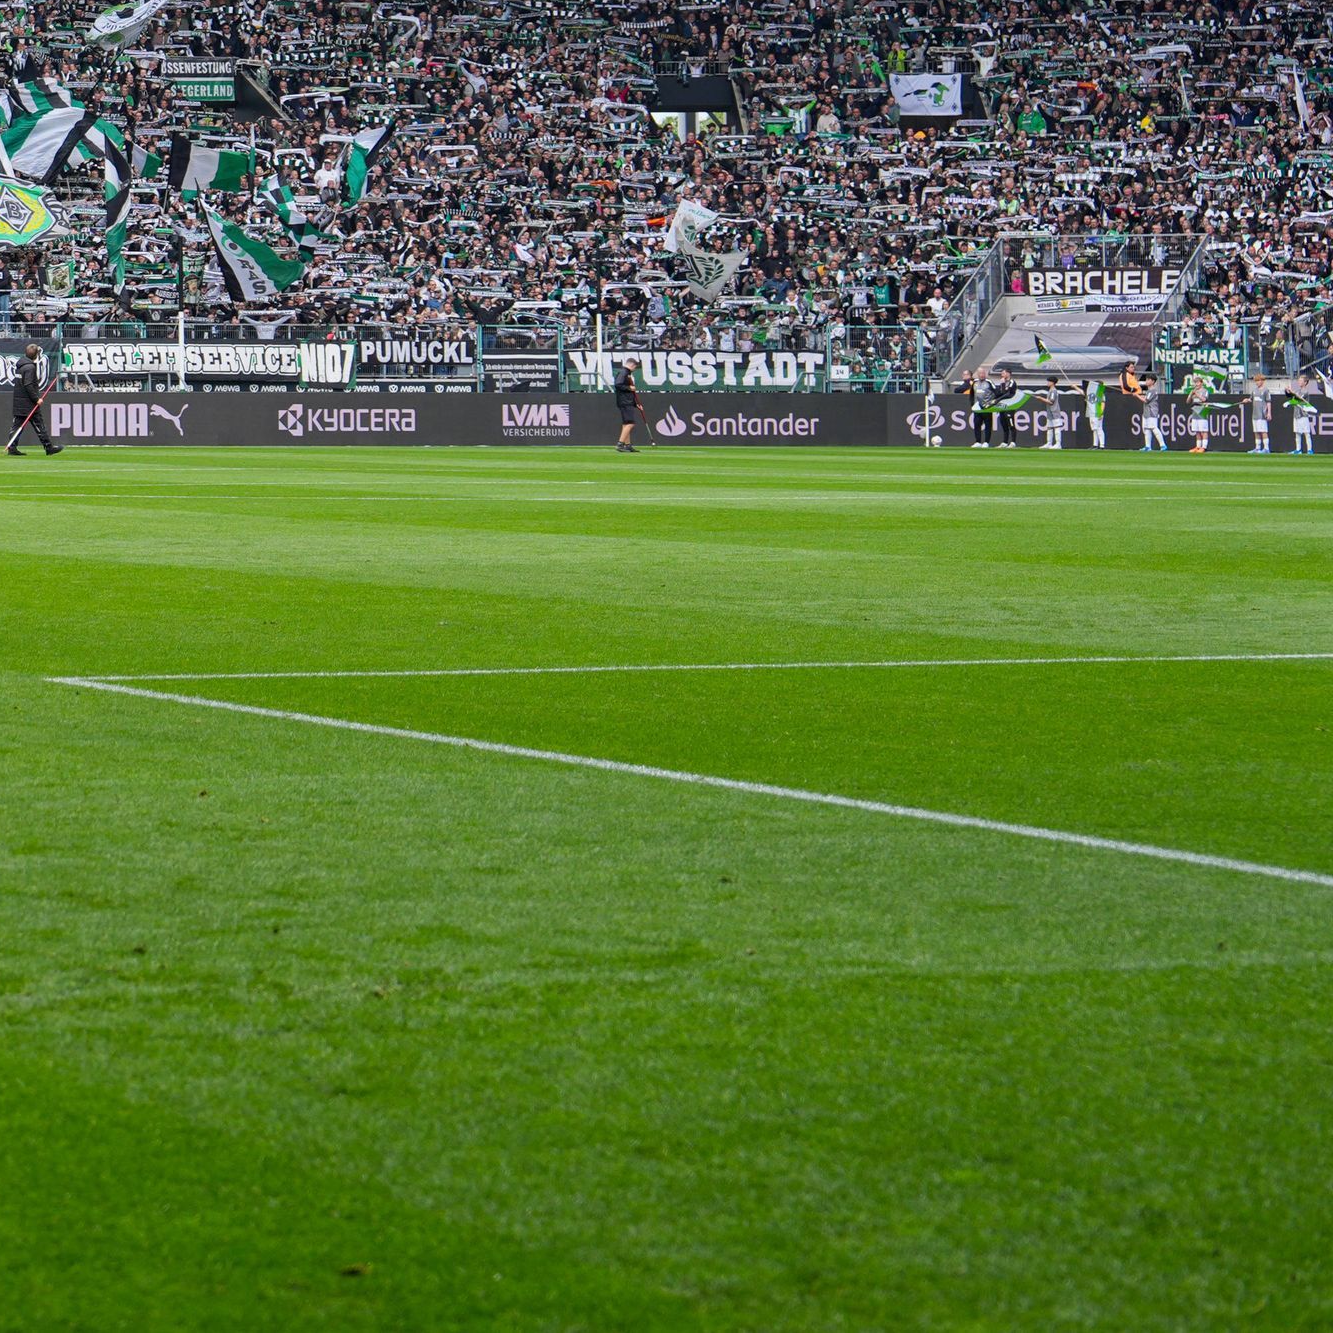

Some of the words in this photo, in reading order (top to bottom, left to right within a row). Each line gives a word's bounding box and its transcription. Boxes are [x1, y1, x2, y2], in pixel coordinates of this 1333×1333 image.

[170, 84, 234, 98] SEGERLAND
[1100, 304, 1154, 313] Remscheid
[66, 344, 298, 374] BEGLEITSERVICE
[361, 341, 473, 364] PUMUCKL
[1155, 346, 1240, 364] NORDHARZ
[568, 351, 824, 387] VITUSSTADT
[214, 383, 240, 392] mewa
[261, 383, 287, 392] mewa
[354, 383, 380, 392] mewa
[400, 383, 426, 392] mewa
[445, 383, 472, 392] mewa
[50, 403, 149, 436] PUMA
[307, 408, 416, 432] KYOCERA
[501, 403, 551, 426] LVM
[501, 427, 571, 437] VERSICHERUNG
[690, 411, 819, 437] Santander
